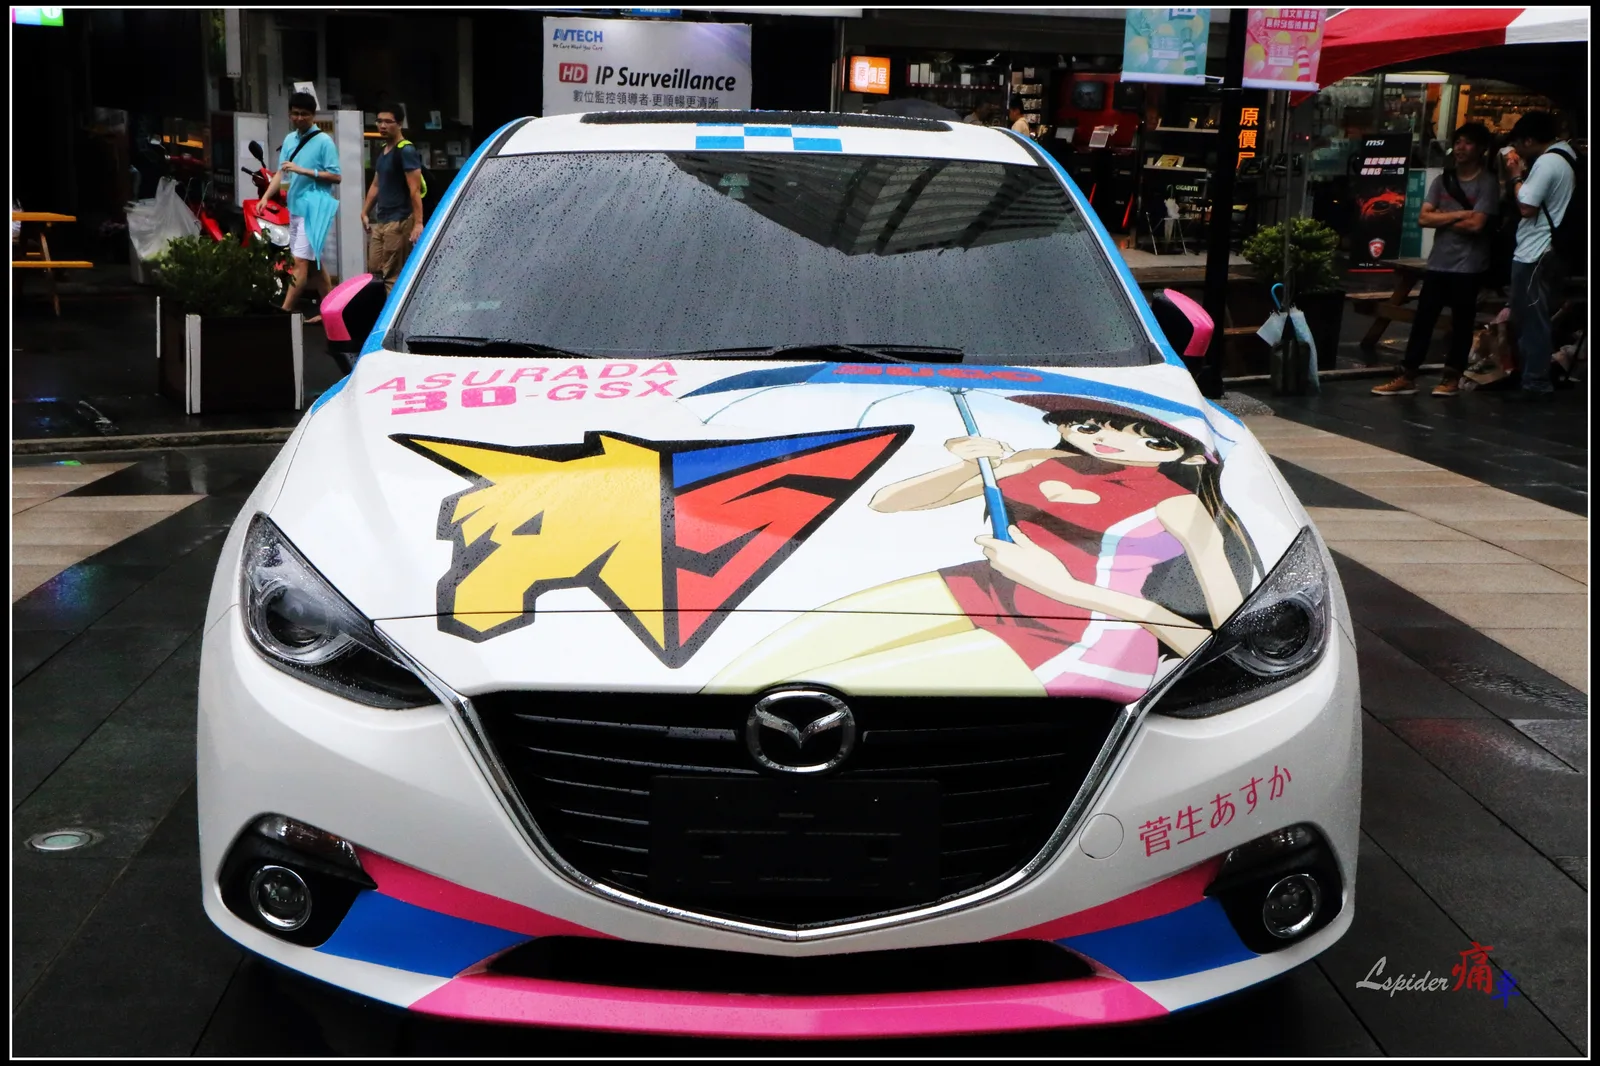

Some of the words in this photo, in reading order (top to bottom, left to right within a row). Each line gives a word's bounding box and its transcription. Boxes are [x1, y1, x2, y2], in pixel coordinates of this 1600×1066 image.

[553, 28, 603, 43] AVTECH
[562, 65, 585, 81] HD
[595, 66, 614, 85] IP
[617, 66, 736, 91] Surveillance
[365, 360, 679, 395] ASURADA
[1138, 765, 1293, 857] 菅生あすか
